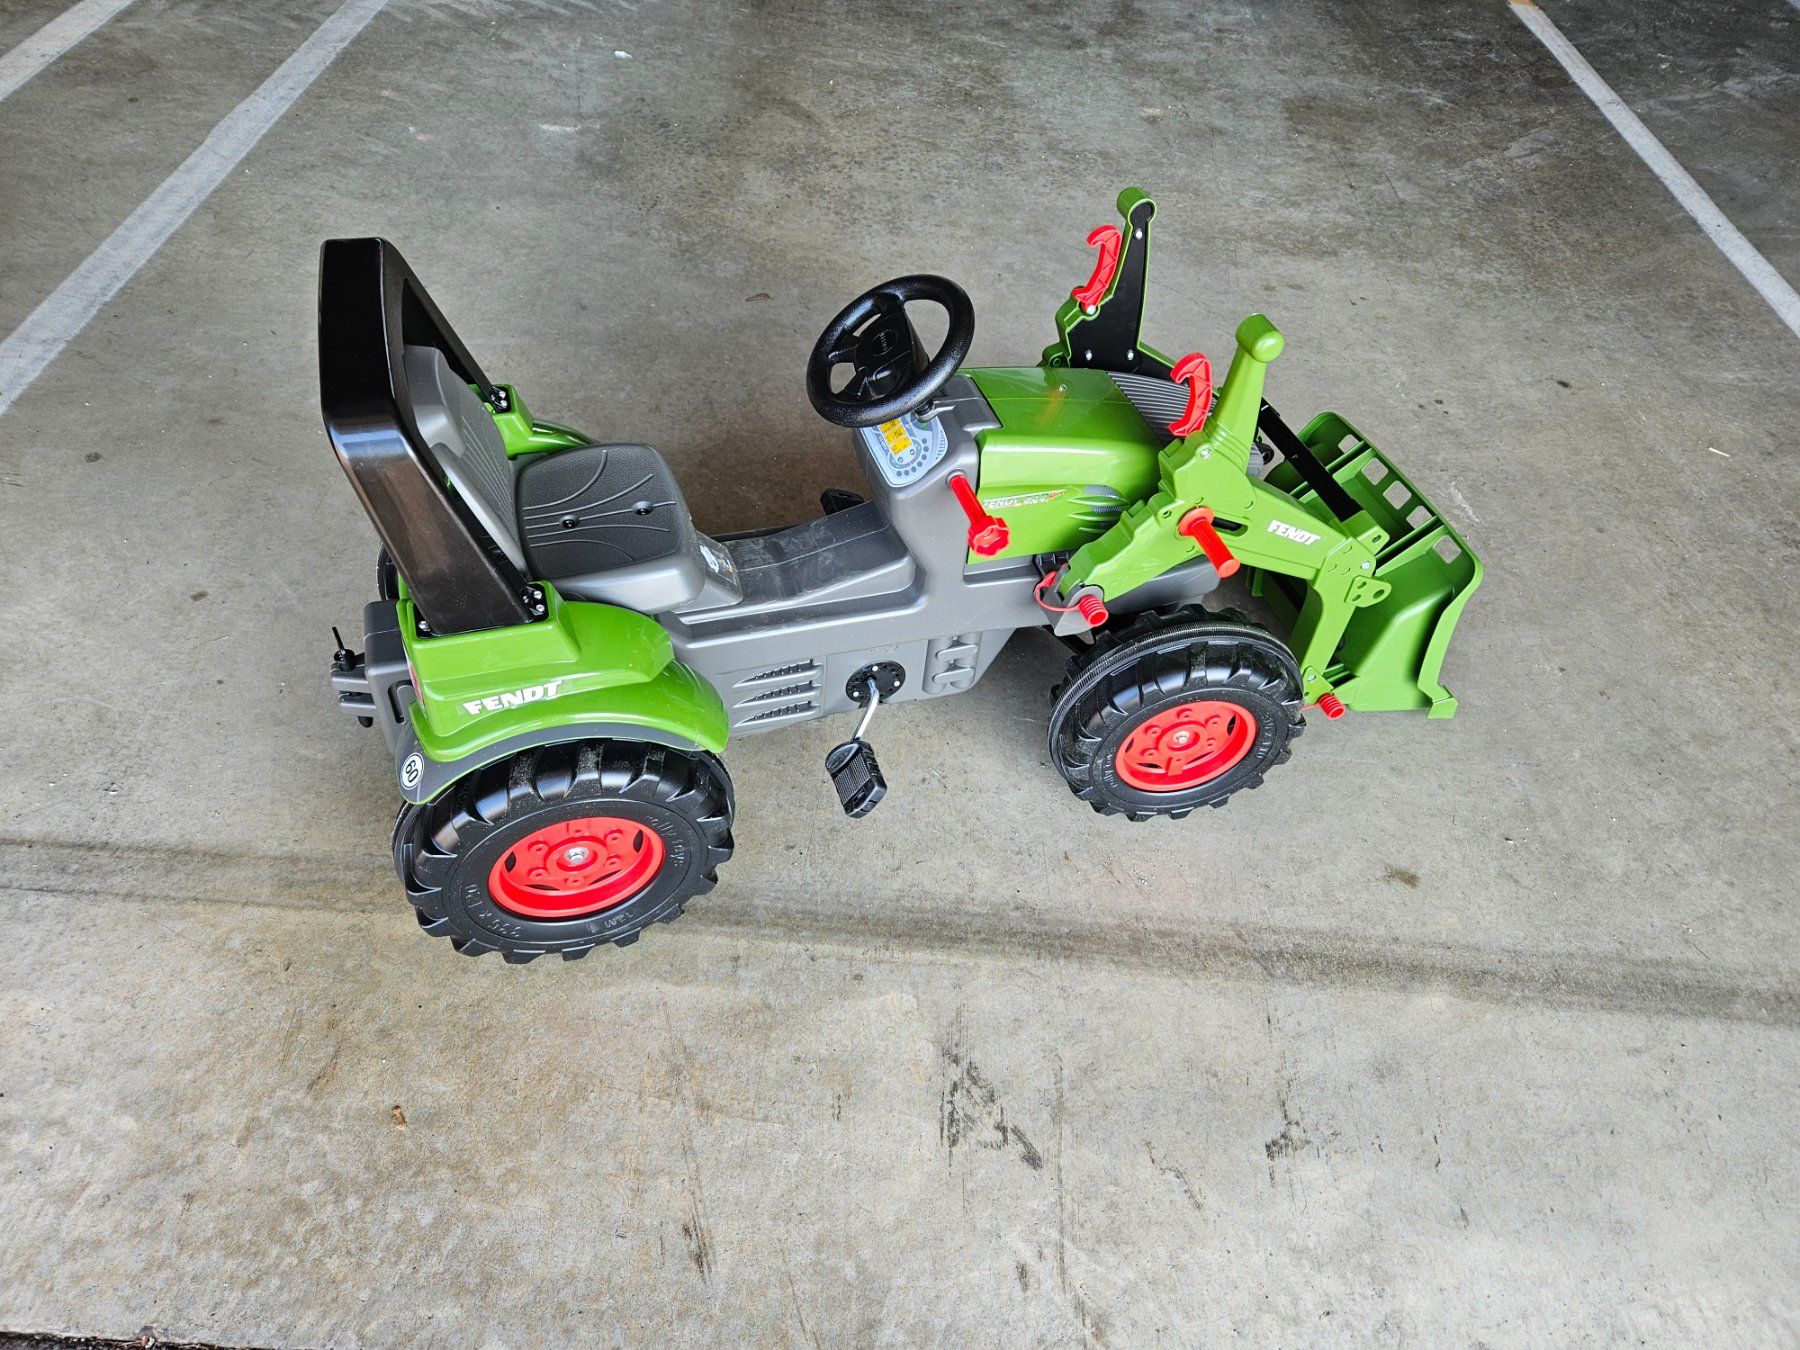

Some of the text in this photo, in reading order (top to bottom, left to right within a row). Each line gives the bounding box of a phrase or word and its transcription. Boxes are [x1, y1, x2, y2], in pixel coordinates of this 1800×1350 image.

[1266, 519, 1322, 546] FENDT
[463, 680, 563, 716] FENDT
[405, 759, 420, 784] 60
